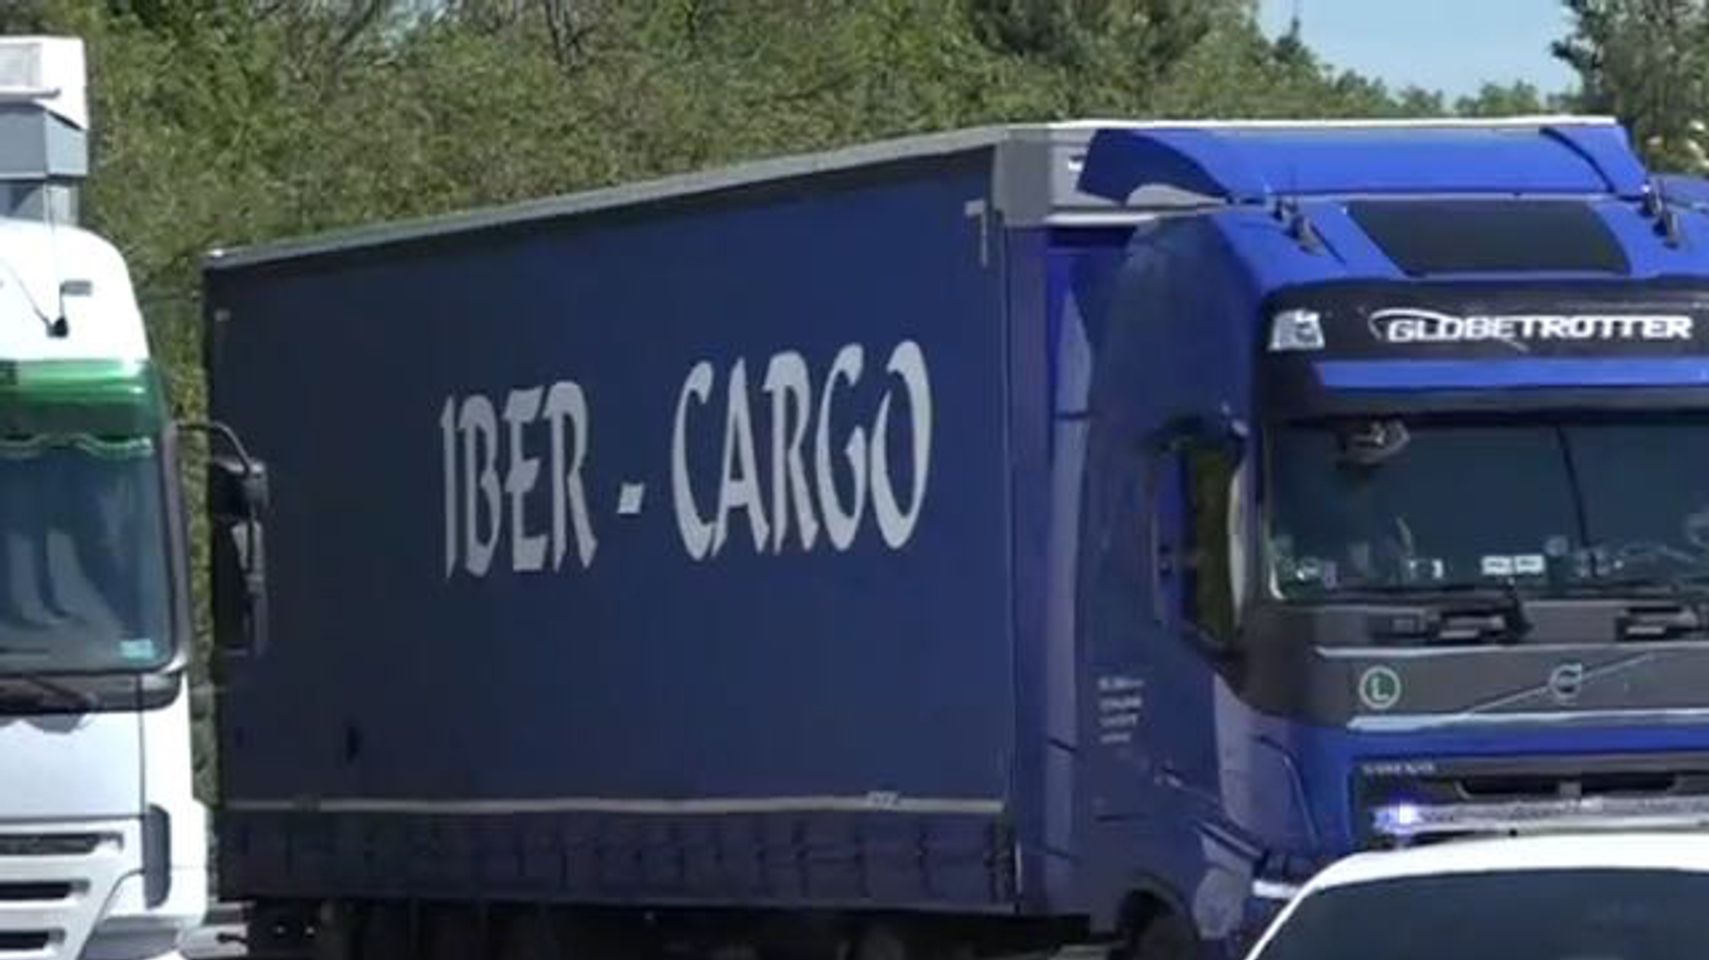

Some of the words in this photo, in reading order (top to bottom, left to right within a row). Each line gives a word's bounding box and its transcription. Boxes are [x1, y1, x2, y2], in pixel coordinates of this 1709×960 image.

[1385, 313, 1693, 343] GLOBETROTTER
[439, 380, 598, 580] IBER
[671, 338, 934, 562] CARGO
